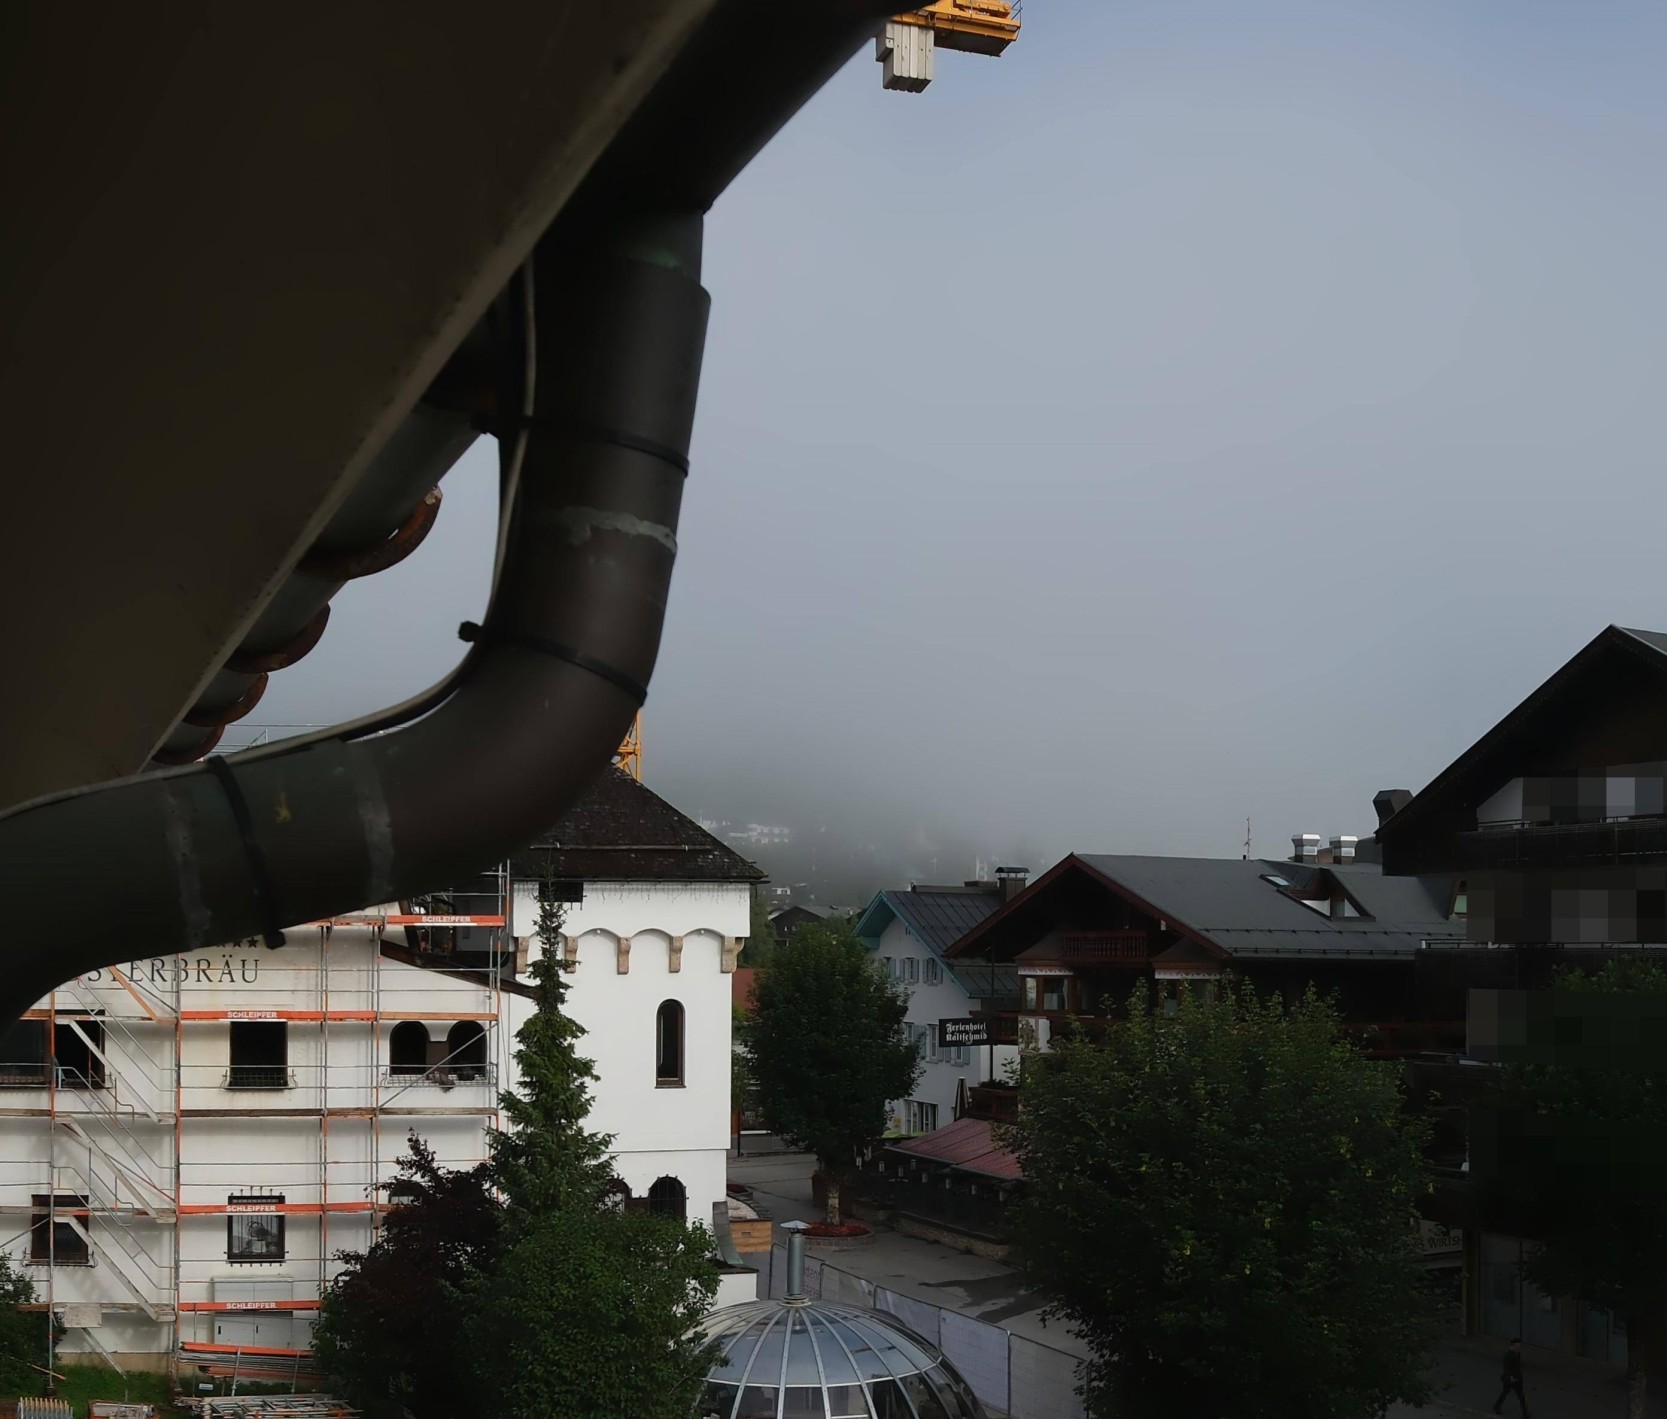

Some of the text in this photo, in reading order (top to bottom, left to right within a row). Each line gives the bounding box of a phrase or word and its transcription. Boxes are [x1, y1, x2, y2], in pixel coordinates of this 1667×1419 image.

[422, 915, 471, 923] SCHLEIPFER
[227, 1011, 277, 1019] SCHLEIPFER
[945, 1021, 986, 1033] Ferienhotel
[226, 1205, 277, 1213] SCHLEIPFER
[226, 1302, 277, 1310] SCHLEIPFER
